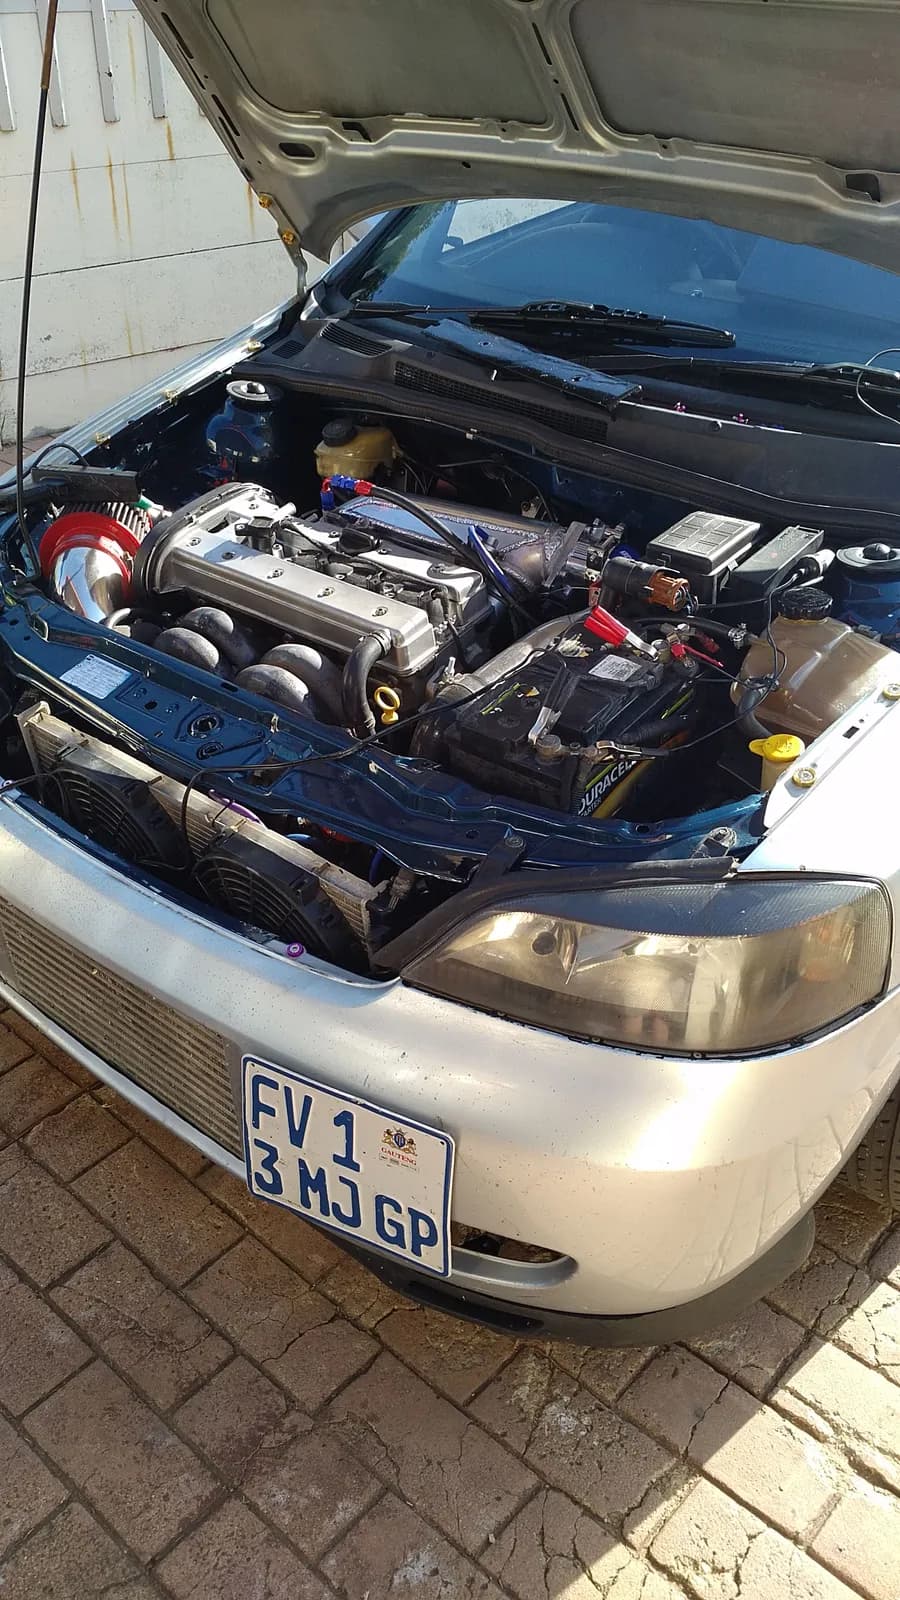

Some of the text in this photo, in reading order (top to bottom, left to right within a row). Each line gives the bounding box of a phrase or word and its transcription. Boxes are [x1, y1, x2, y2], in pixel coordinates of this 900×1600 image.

[252, 1075, 360, 1172] FV 1
[381, 1147, 417, 1166] GAUTENG
[253, 1138, 438, 1257] 3 MJ GP
